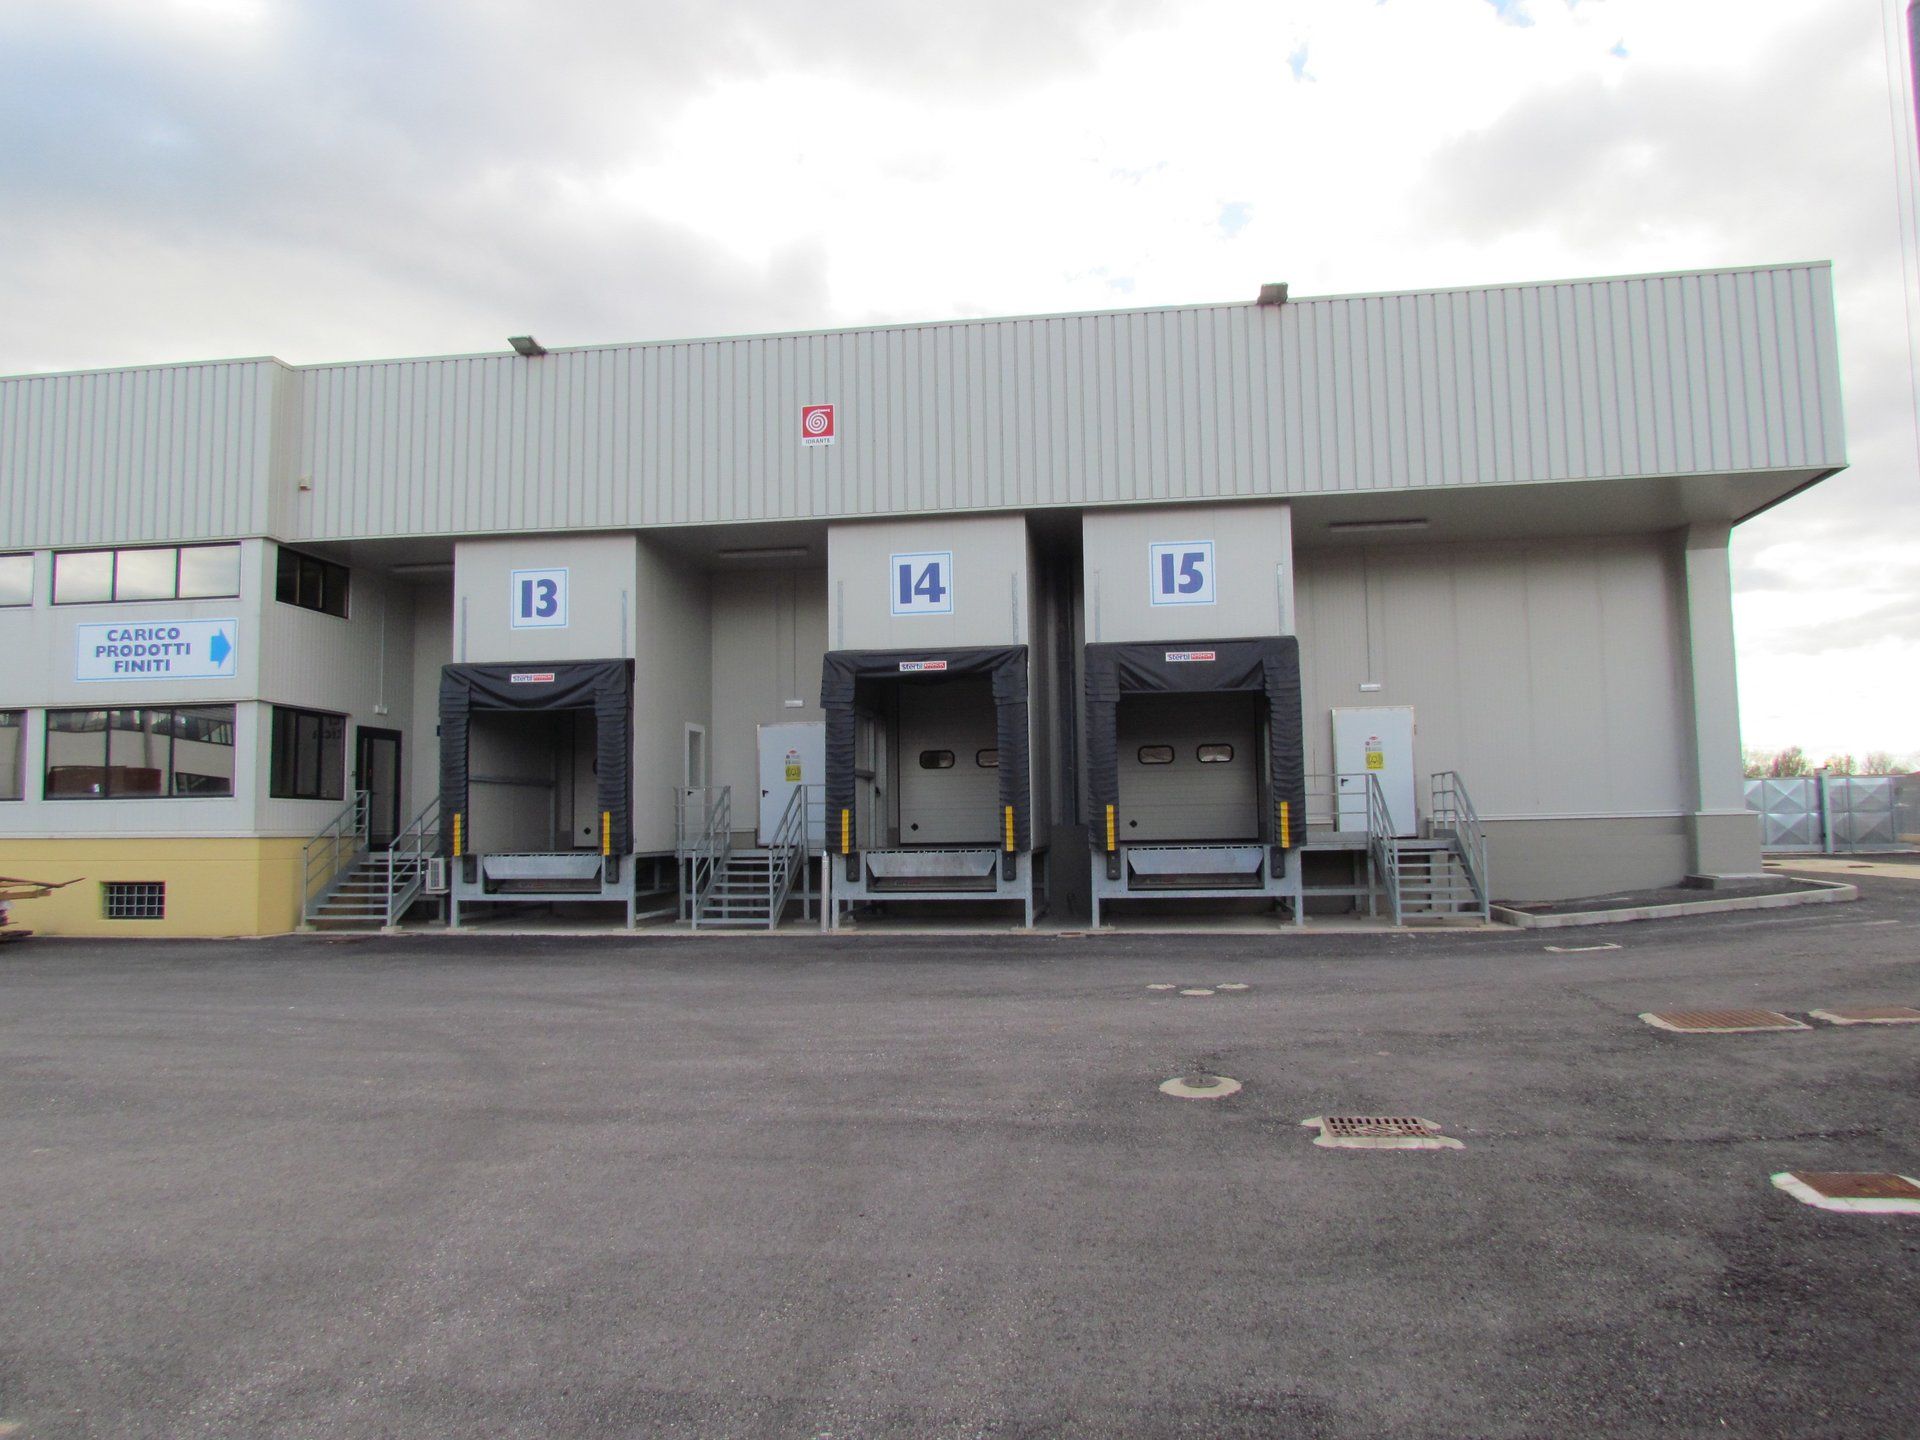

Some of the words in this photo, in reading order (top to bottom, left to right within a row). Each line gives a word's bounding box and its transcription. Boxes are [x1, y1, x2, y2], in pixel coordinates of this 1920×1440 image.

[899, 562, 946, 604] 14
[1161, 552, 1204, 594] 15
[521, 578, 558, 618] 13
[107, 627, 180, 642] CARICO
[96, 643, 191, 657] PRODOTTI
[114, 659, 171, 673] FINITI
